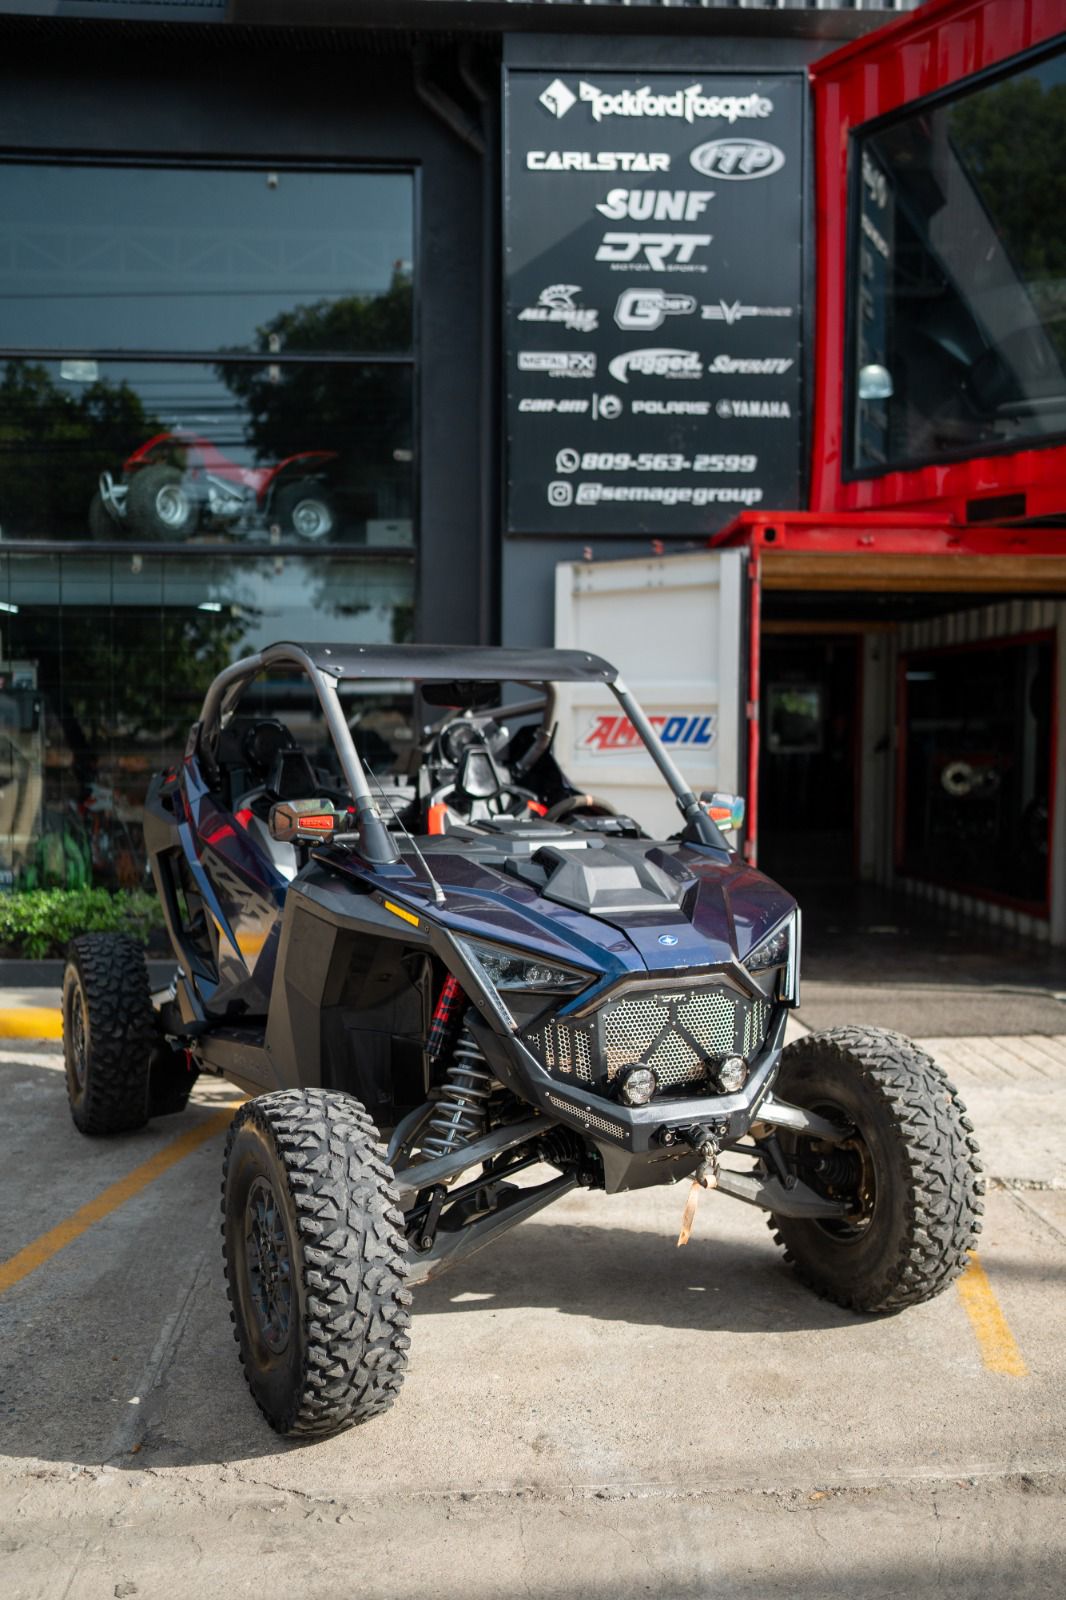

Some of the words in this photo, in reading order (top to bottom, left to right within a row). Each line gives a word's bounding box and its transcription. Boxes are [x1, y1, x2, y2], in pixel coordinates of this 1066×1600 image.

[579, 81, 684, 122] Rockford
[527, 151, 671, 171] CARLSTAR
[700, 145, 775, 174] ITP
[596, 188, 715, 221] SUNF
[595, 232, 713, 272] DRT
[631, 400, 711, 415] POLARIS
[731, 400, 791, 418] YAMAHA
[581, 453, 758, 473] 809-563-2599
